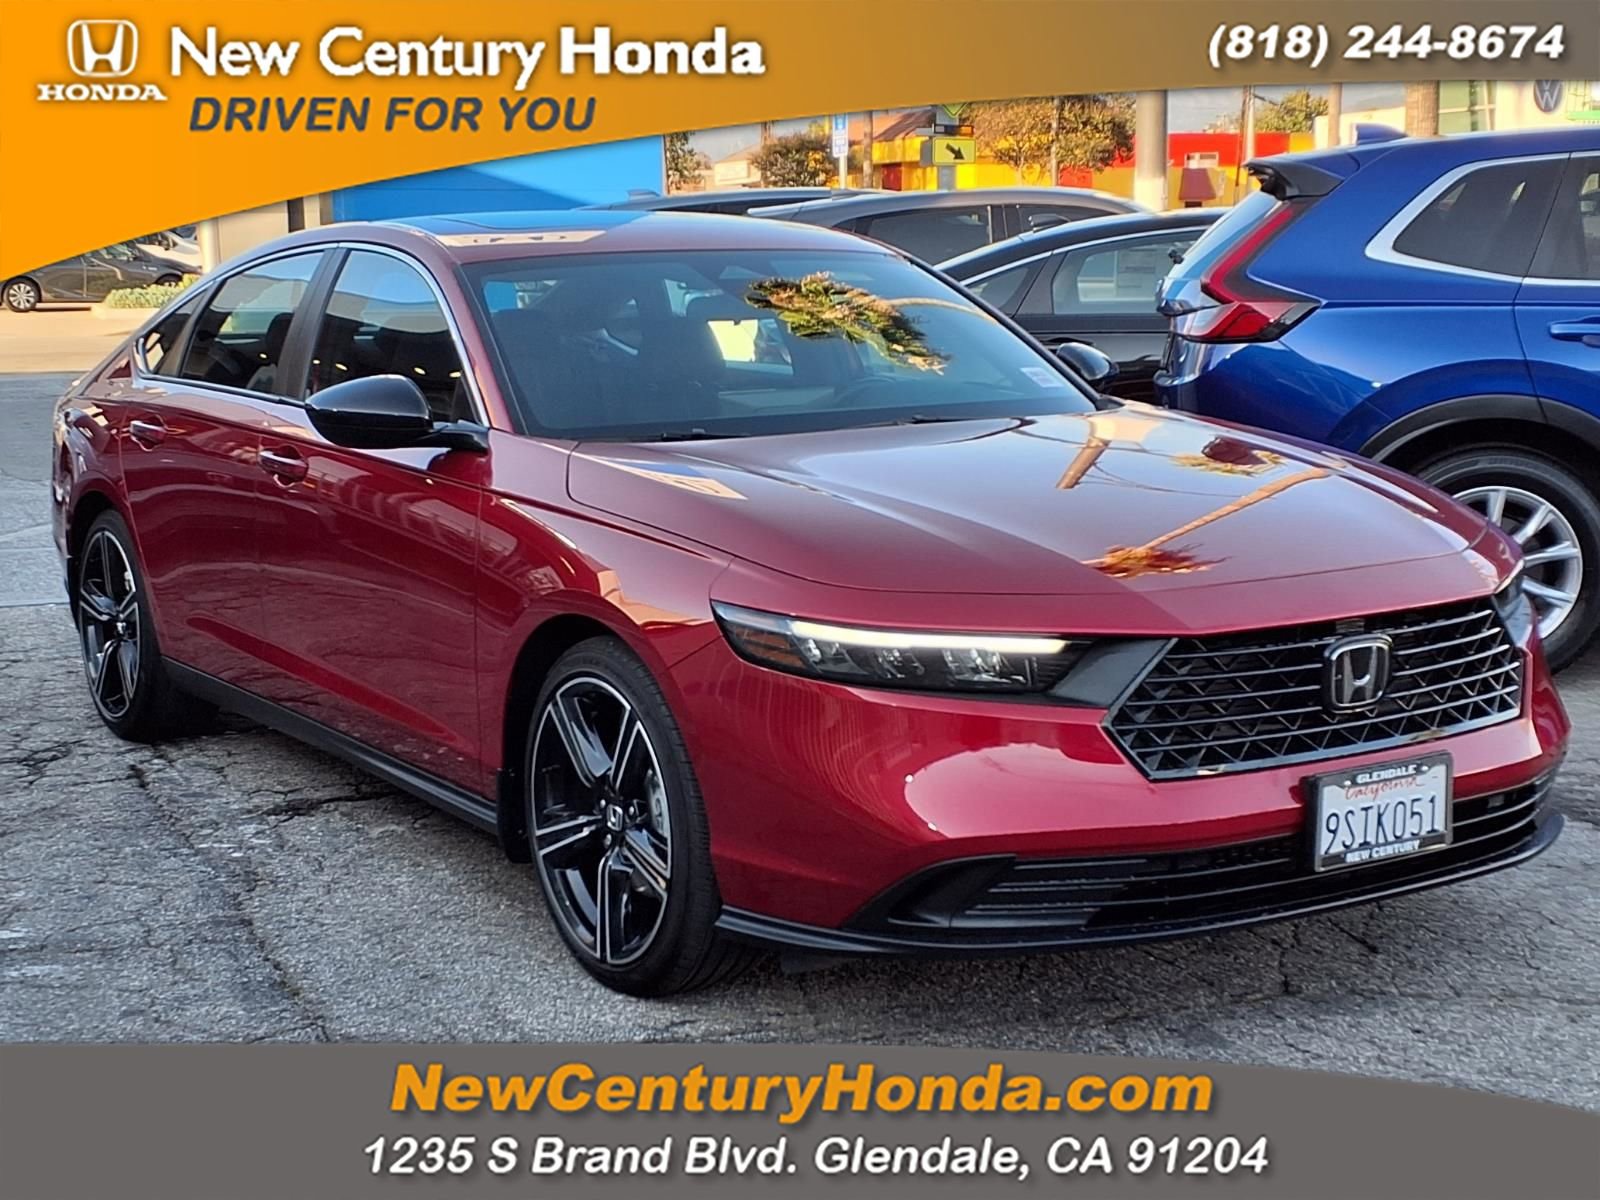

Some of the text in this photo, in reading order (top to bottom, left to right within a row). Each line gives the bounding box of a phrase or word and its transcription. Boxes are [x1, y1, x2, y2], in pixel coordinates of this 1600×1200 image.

[1356, 764, 1418, 784] GLENDALE
[1325, 794, 1440, 855] 9SIK051
[1371, 839, 1421, 859] CENTURY
